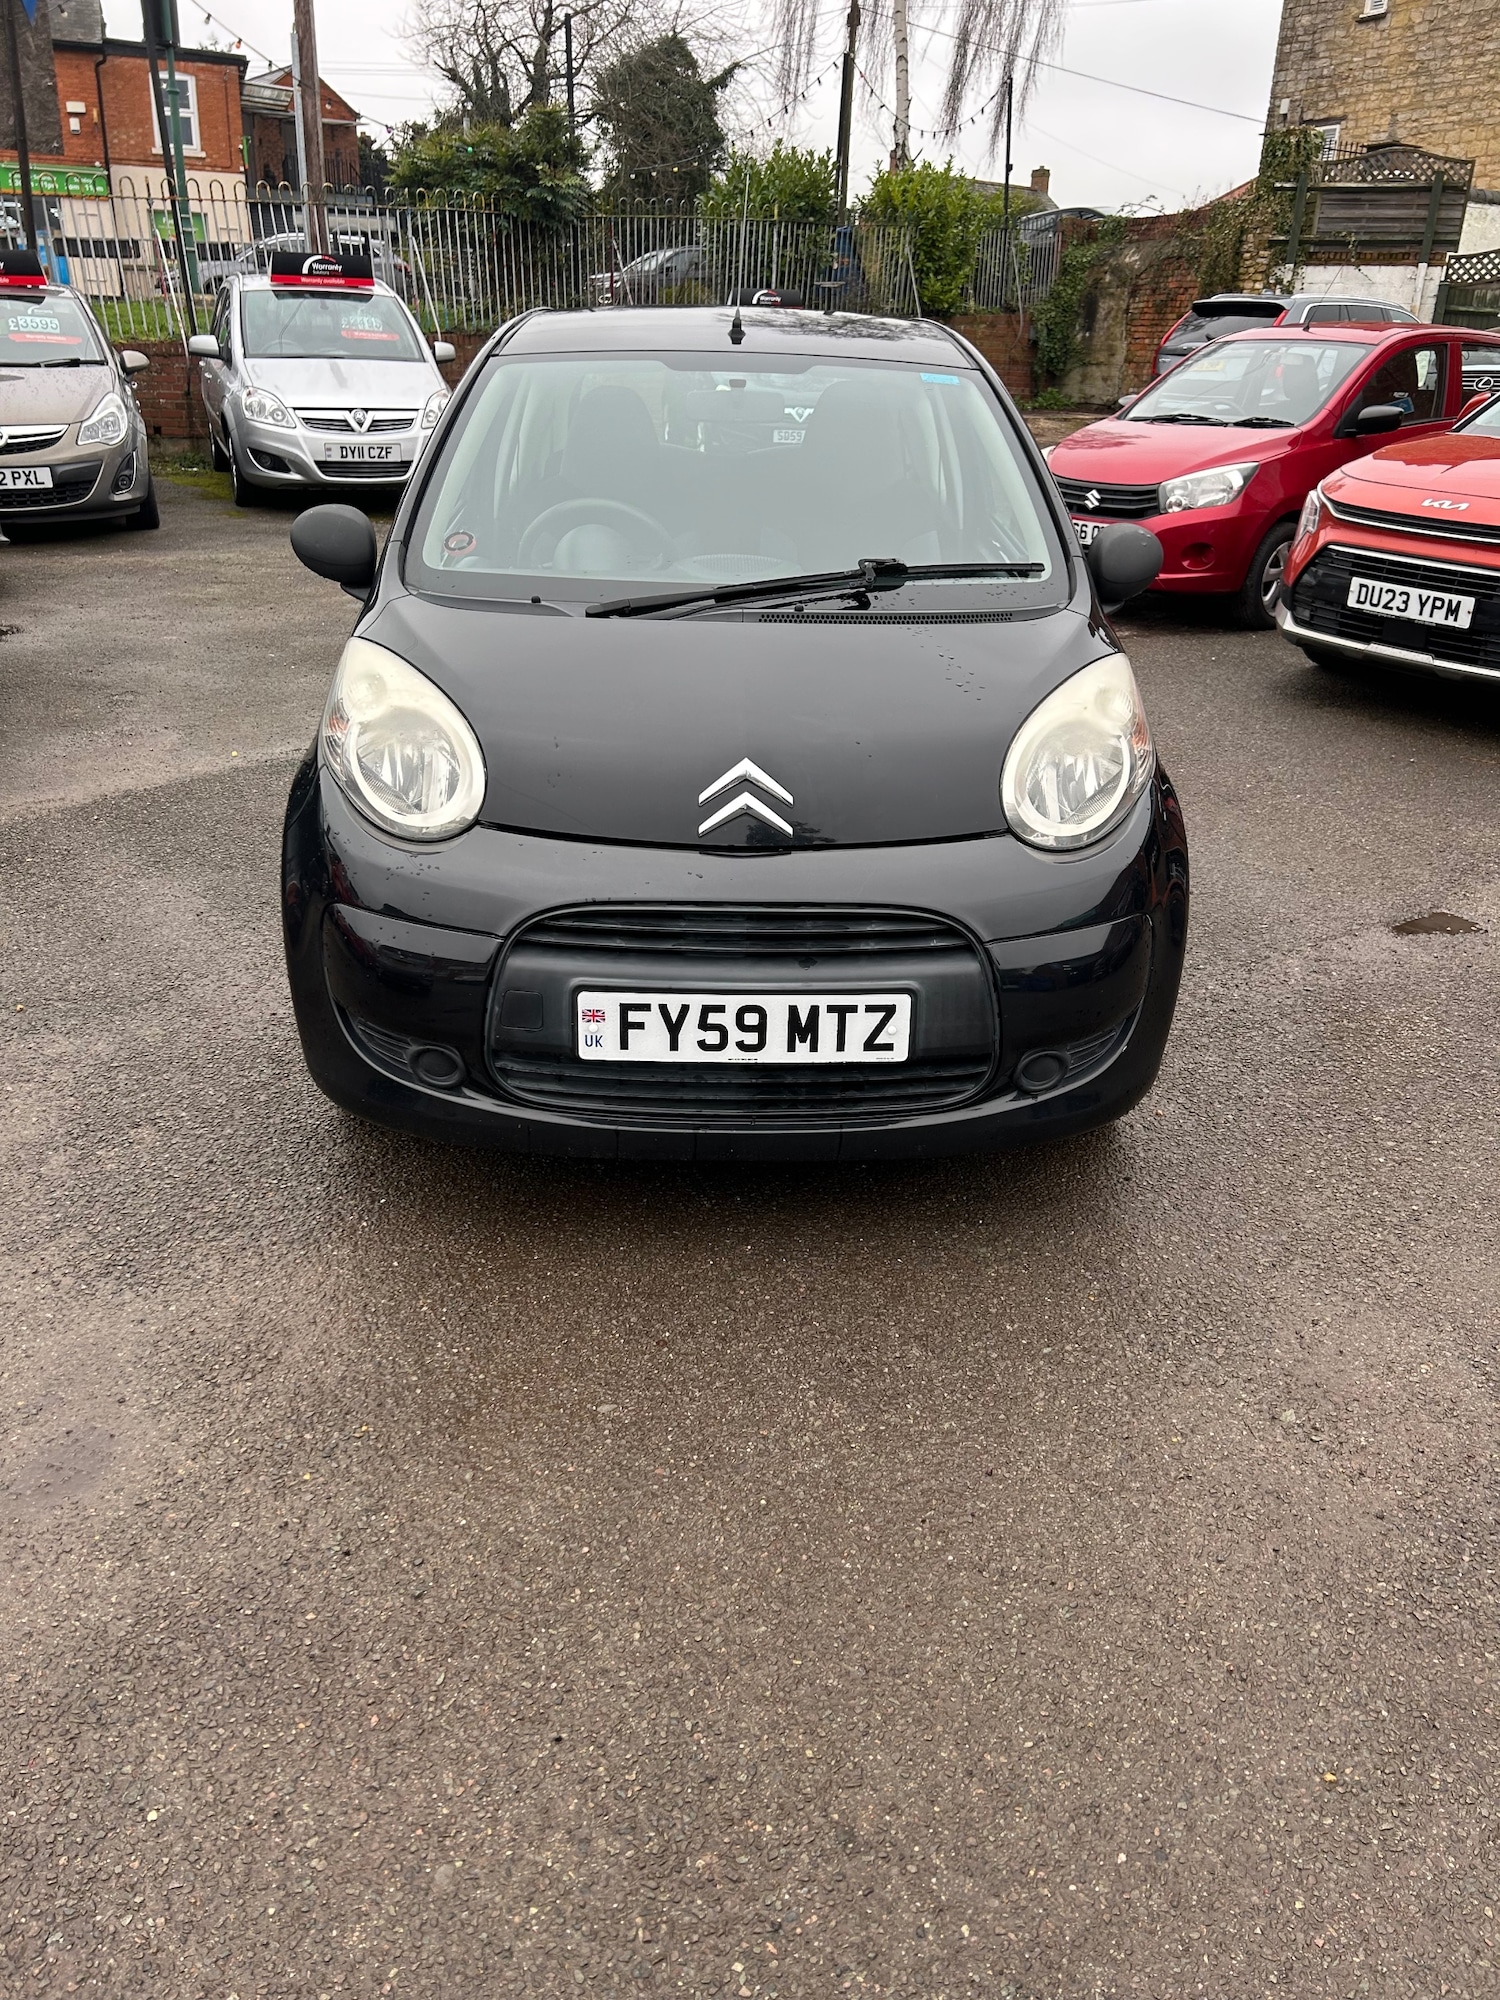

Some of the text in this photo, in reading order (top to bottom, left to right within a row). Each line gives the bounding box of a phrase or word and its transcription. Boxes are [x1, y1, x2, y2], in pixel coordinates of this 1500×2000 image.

[312, 263, 343, 272] Warranty
[339, 446, 393, 459] DY11 CZF
[11, 470, 45, 486] PXL
[1355, 583, 1462, 622] DU23 YPM
[619, 1002, 897, 1053] FY59 MTZ
[584, 1034, 604, 1048] UK
